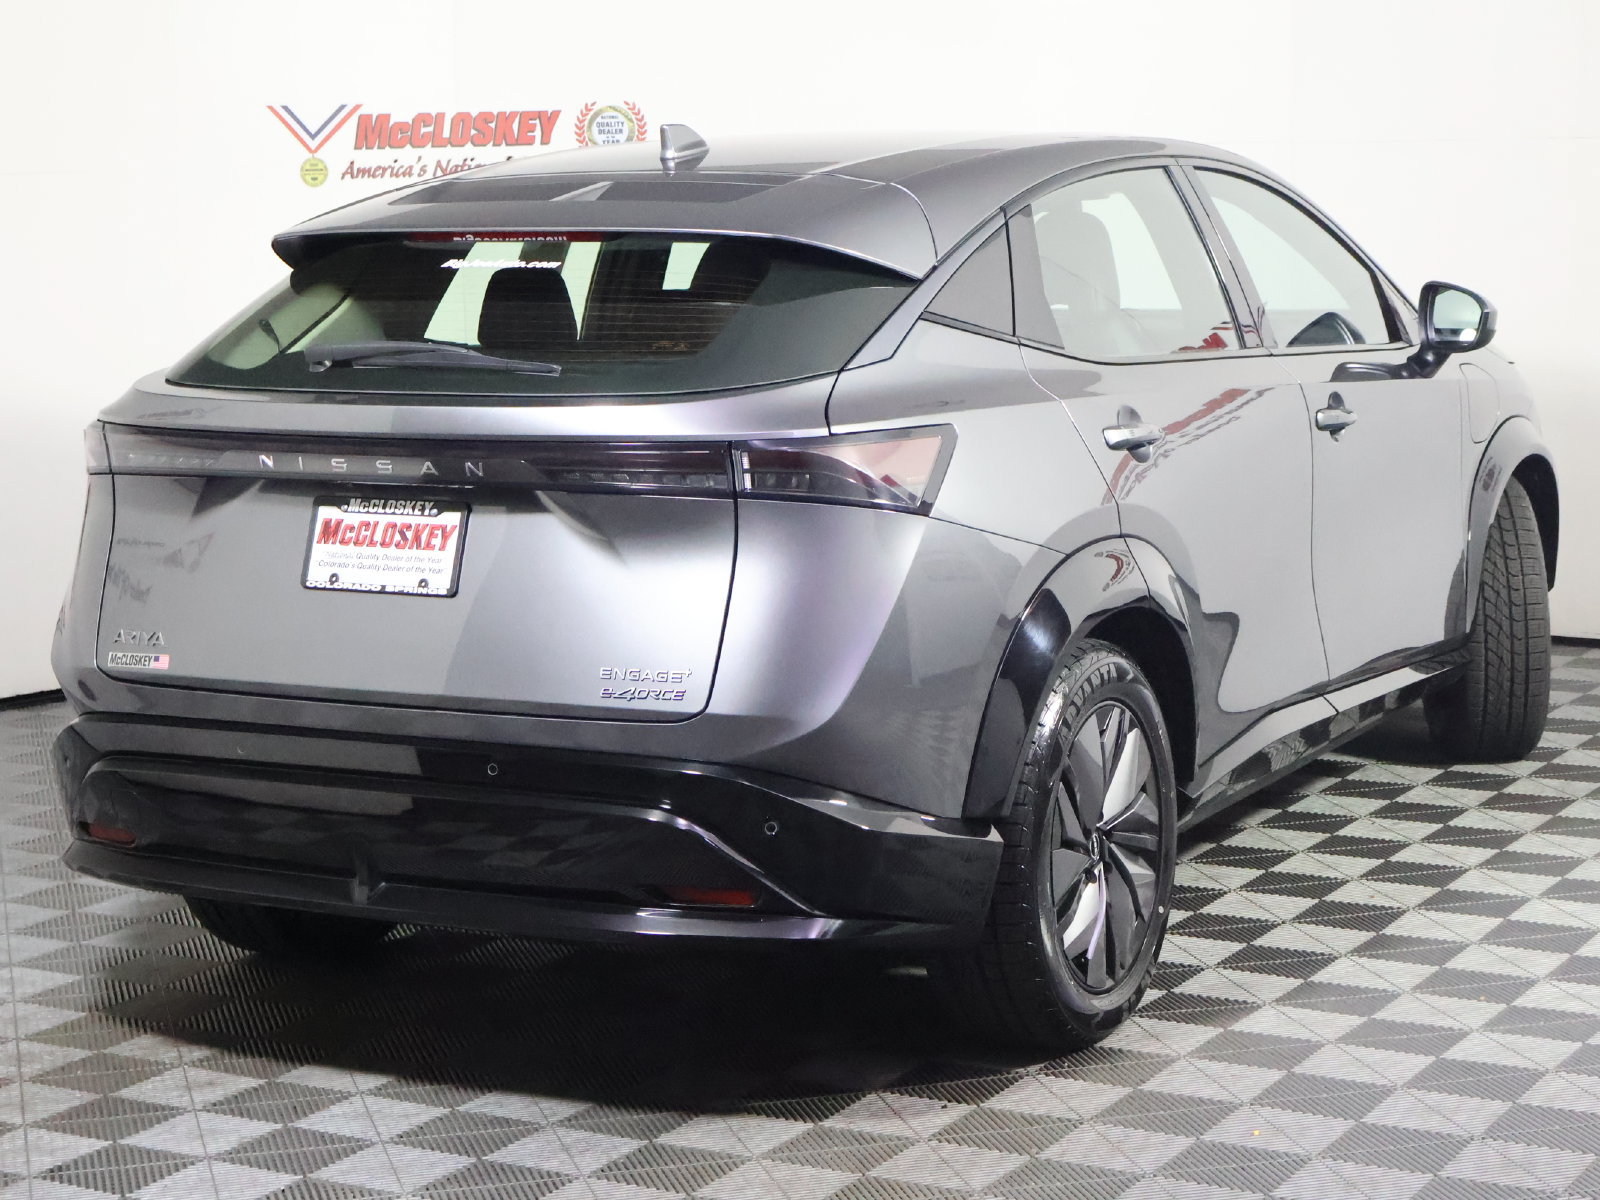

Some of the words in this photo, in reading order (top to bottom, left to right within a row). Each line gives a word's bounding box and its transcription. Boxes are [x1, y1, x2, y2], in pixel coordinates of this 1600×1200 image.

[354, 109, 562, 150] McCLOSKEY
[341, 156, 427, 180] America's
[259, 454, 484, 477] NISSAN
[347, 498, 435, 516] McCLOSKEY
[316, 518, 458, 551] McCLOSKEY
[356, 552, 380, 561] Quality
[382, 554, 403, 562] Dealer
[357, 562, 382, 572] Quality
[383, 564, 404, 572] Dealer
[415, 566, 426, 574] the
[305, 580, 381, 592] COLORADO
[385, 584, 448, 595] SPRINGS
[113, 628, 165, 647] ARIYA
[109, 653, 153, 667] McCLOSKEY
